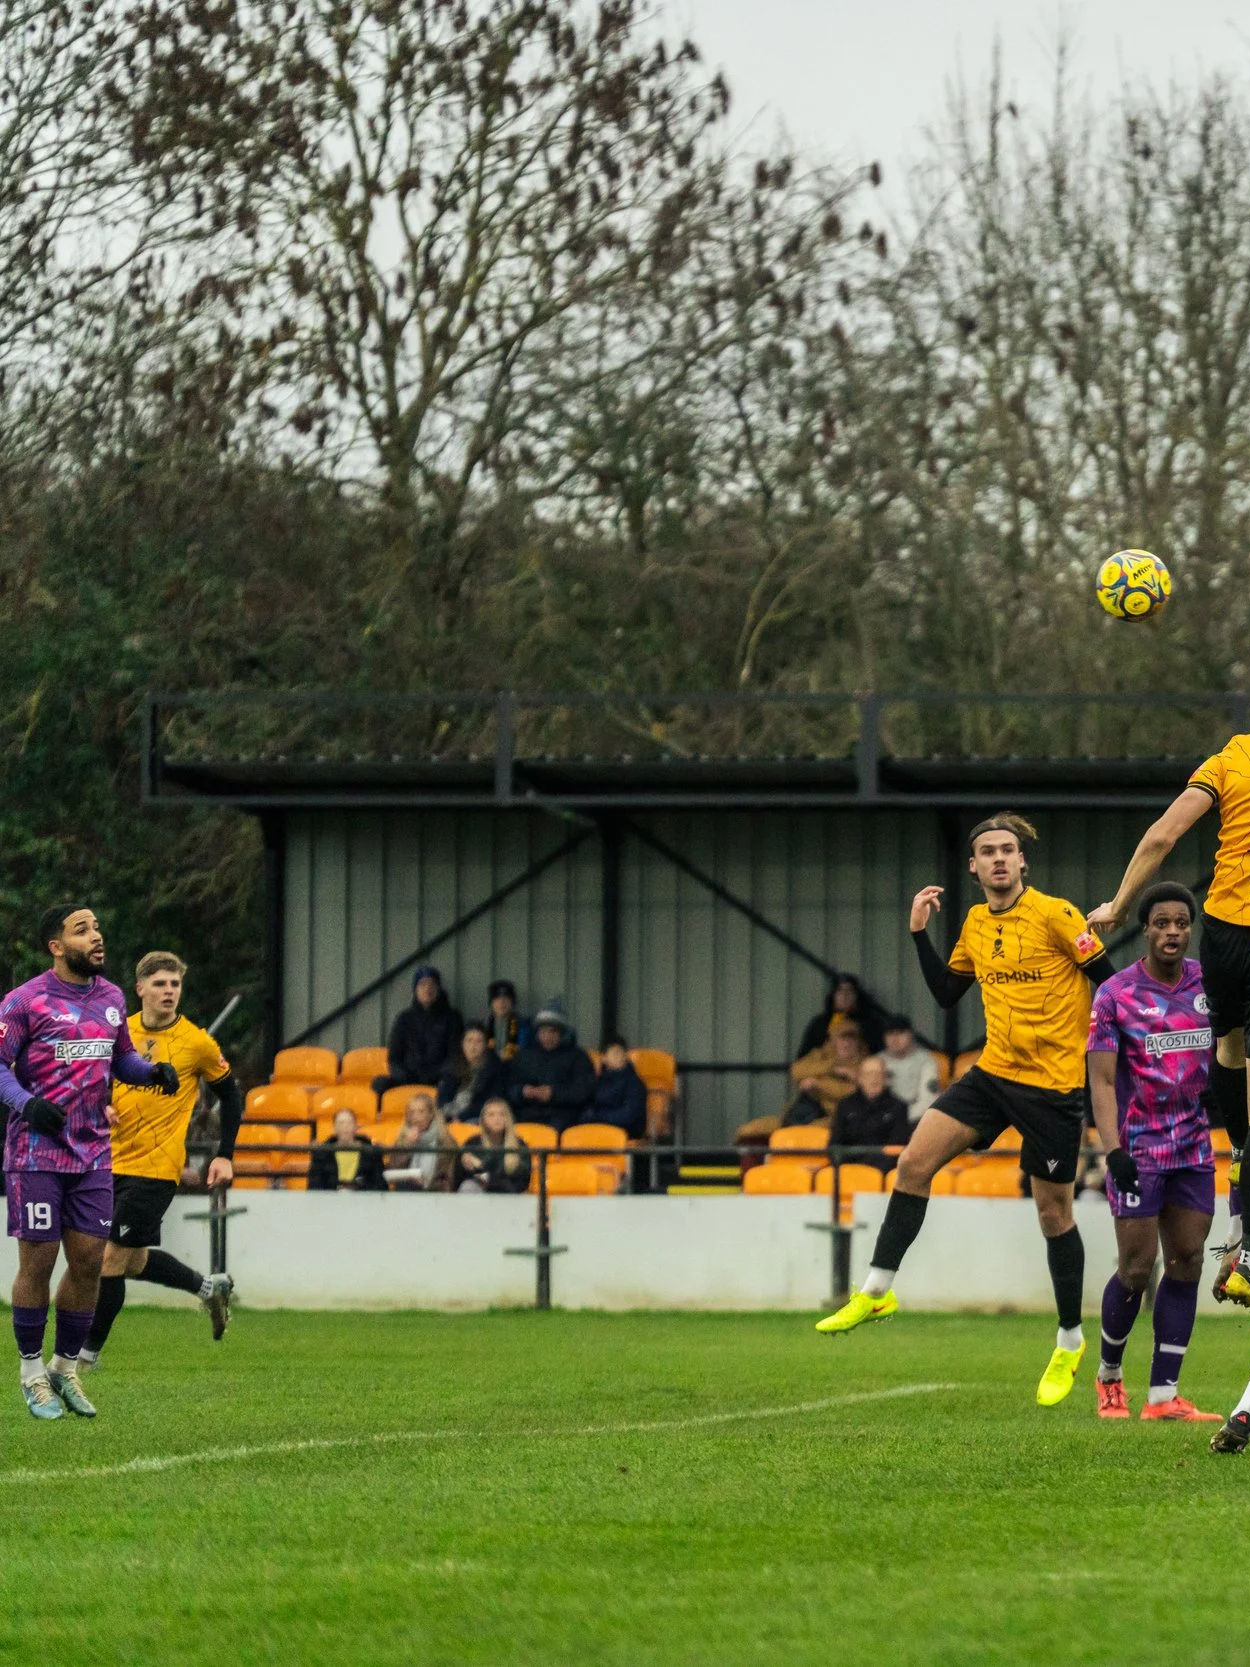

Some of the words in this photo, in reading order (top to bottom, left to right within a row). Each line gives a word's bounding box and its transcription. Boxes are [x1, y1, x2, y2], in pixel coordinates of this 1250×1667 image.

[1158, 1032, 1210, 1048] COSTINGS
[70, 1044, 113, 1056] COSTING
[25, 1202, 52, 1230] 19
